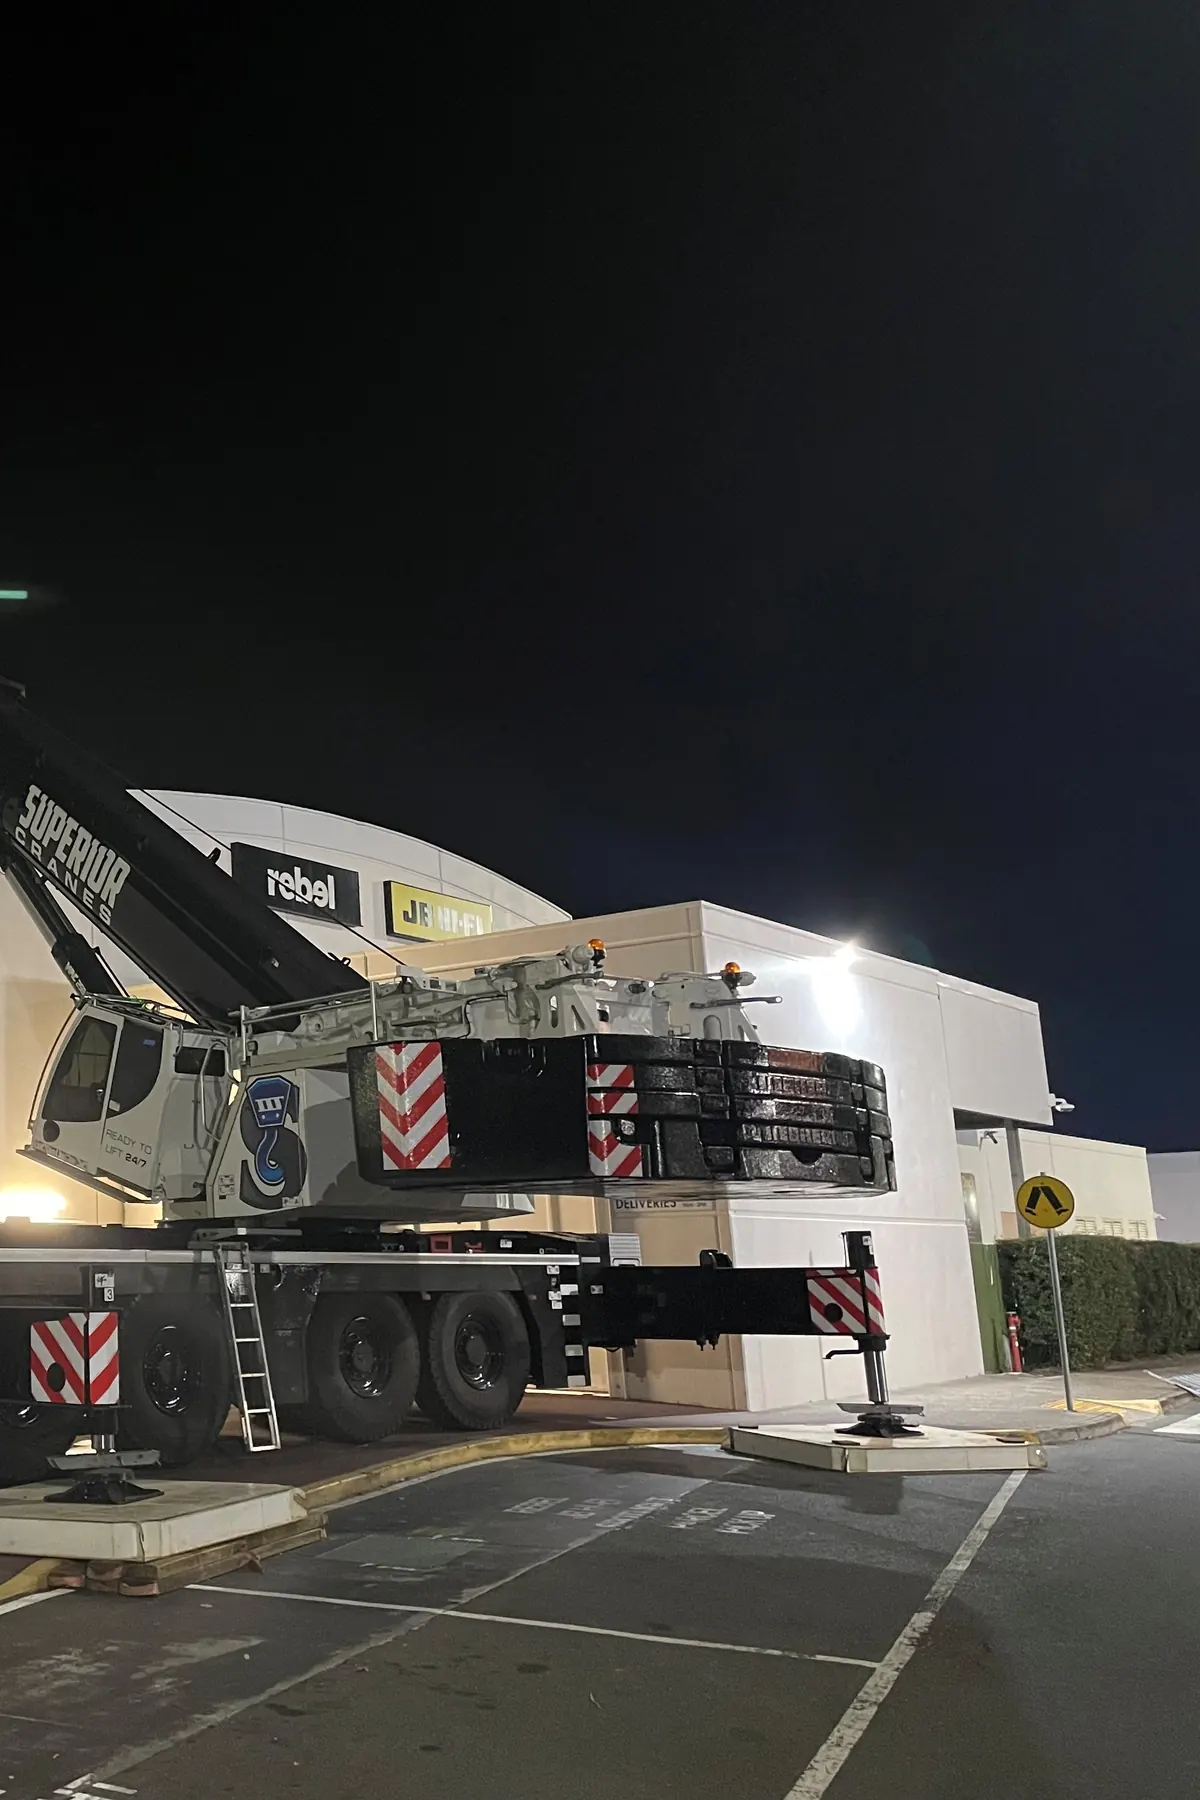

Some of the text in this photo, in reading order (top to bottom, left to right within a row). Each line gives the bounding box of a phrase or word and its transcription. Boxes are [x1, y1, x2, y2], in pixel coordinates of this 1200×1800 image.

[18, 784, 131, 909] SUPERIOR
[15, 826, 111, 926] CRANES
[267, 867, 336, 909] rebel
[403, 900, 434, 928] JB
[106, 1128, 153, 1155] READY TO
[105, 1144, 147, 1168] LIFT 24/7
[616, 1199, 677, 1210] DELIVERIES
